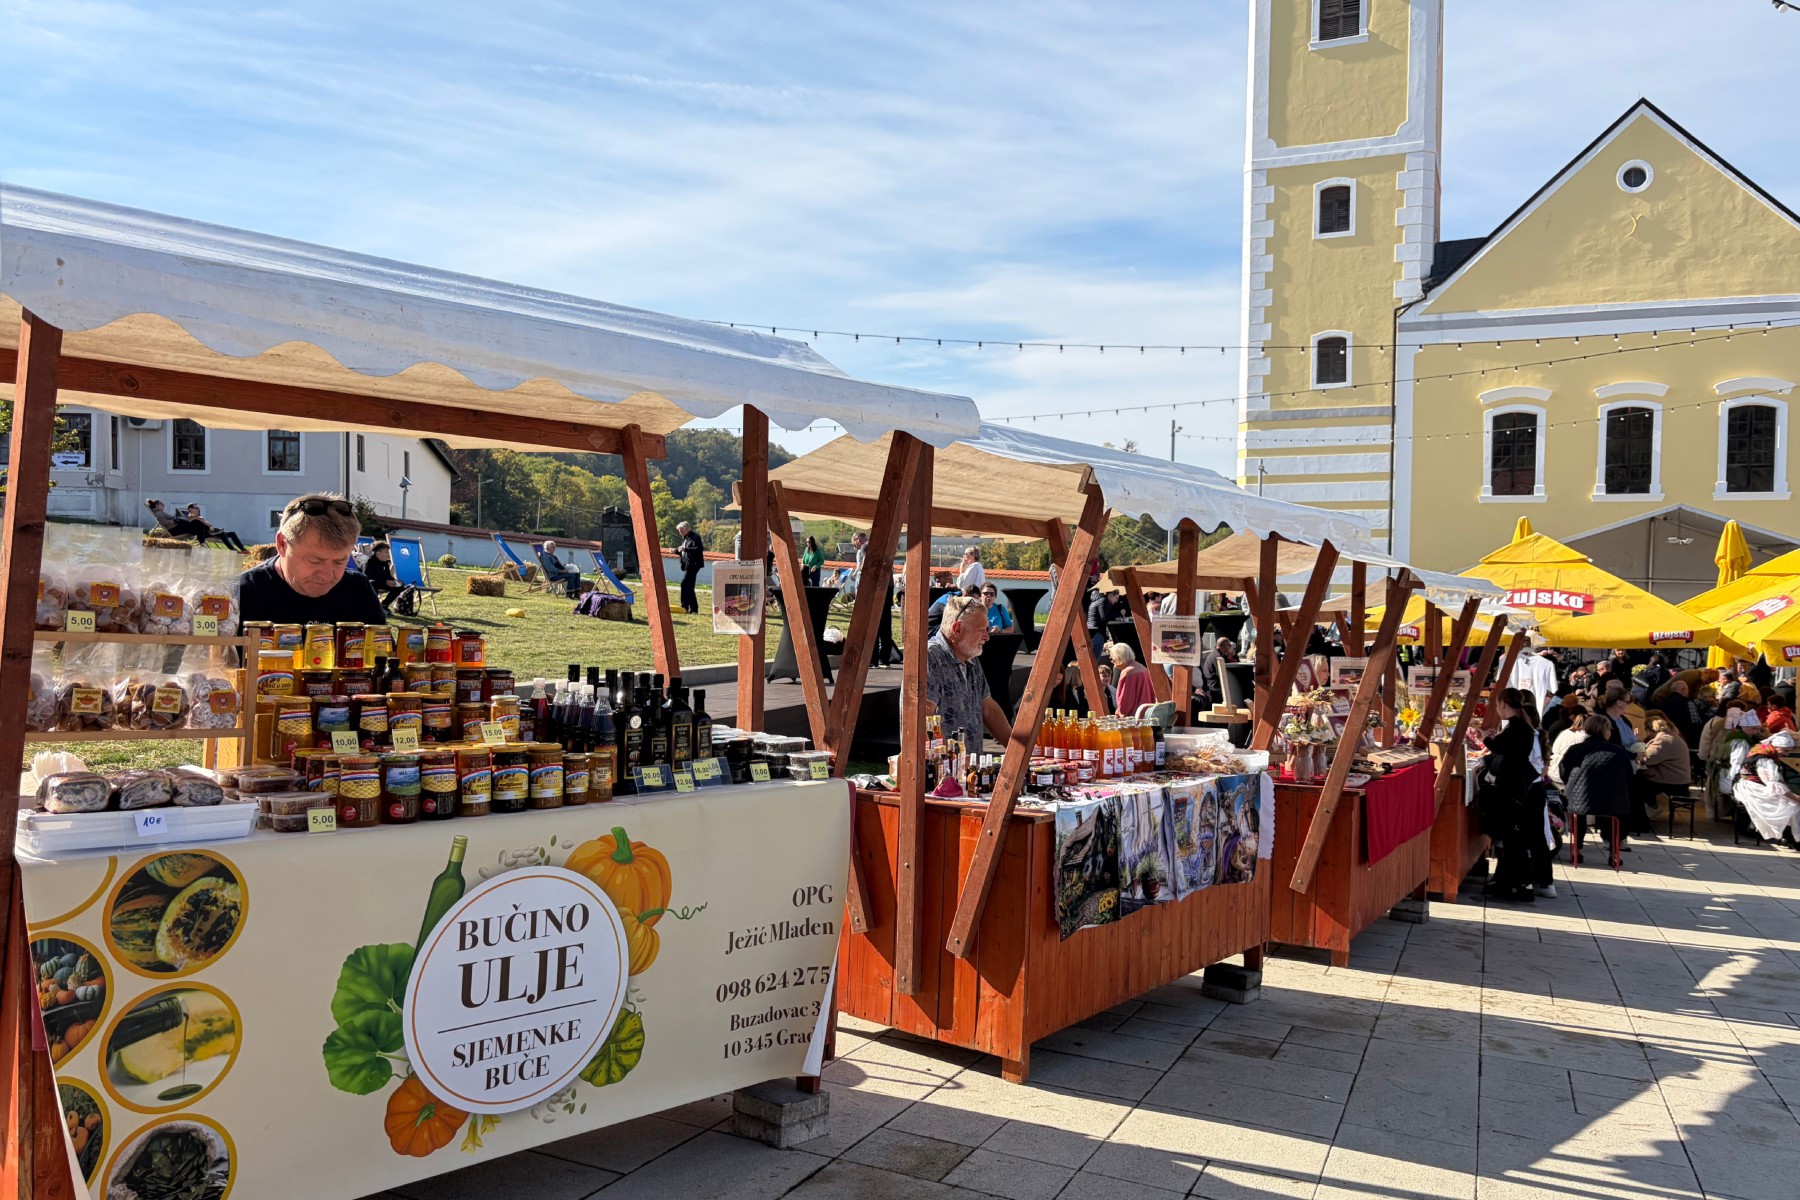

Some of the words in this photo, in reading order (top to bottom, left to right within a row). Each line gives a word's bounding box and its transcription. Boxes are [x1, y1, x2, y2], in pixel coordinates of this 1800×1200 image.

[1503, 589, 1584, 609] žujsko
[71, 616, 93, 626] 5,00
[196, 621, 216, 629] 3,00
[336, 738, 356, 746] 10,00
[312, 814, 334, 825] 5,00
[792, 884, 834, 908] OPG
[456, 902, 590, 952] BUČINO
[725, 926, 767, 955] Ježić
[769, 916, 834, 943] Mladen
[458, 942, 584, 1009] ULJE
[716, 978, 752, 1003] 098
[755, 970, 790, 994] 624
[792, 966, 831, 987] 275
[730, 1005, 809, 1032] Buzadovac
[452, 1018, 582, 1069] SJEMENKE
[722, 1040, 742, 1060] 10
[744, 1031, 773, 1055] 345
[484, 1052, 551, 1091] BUČE
